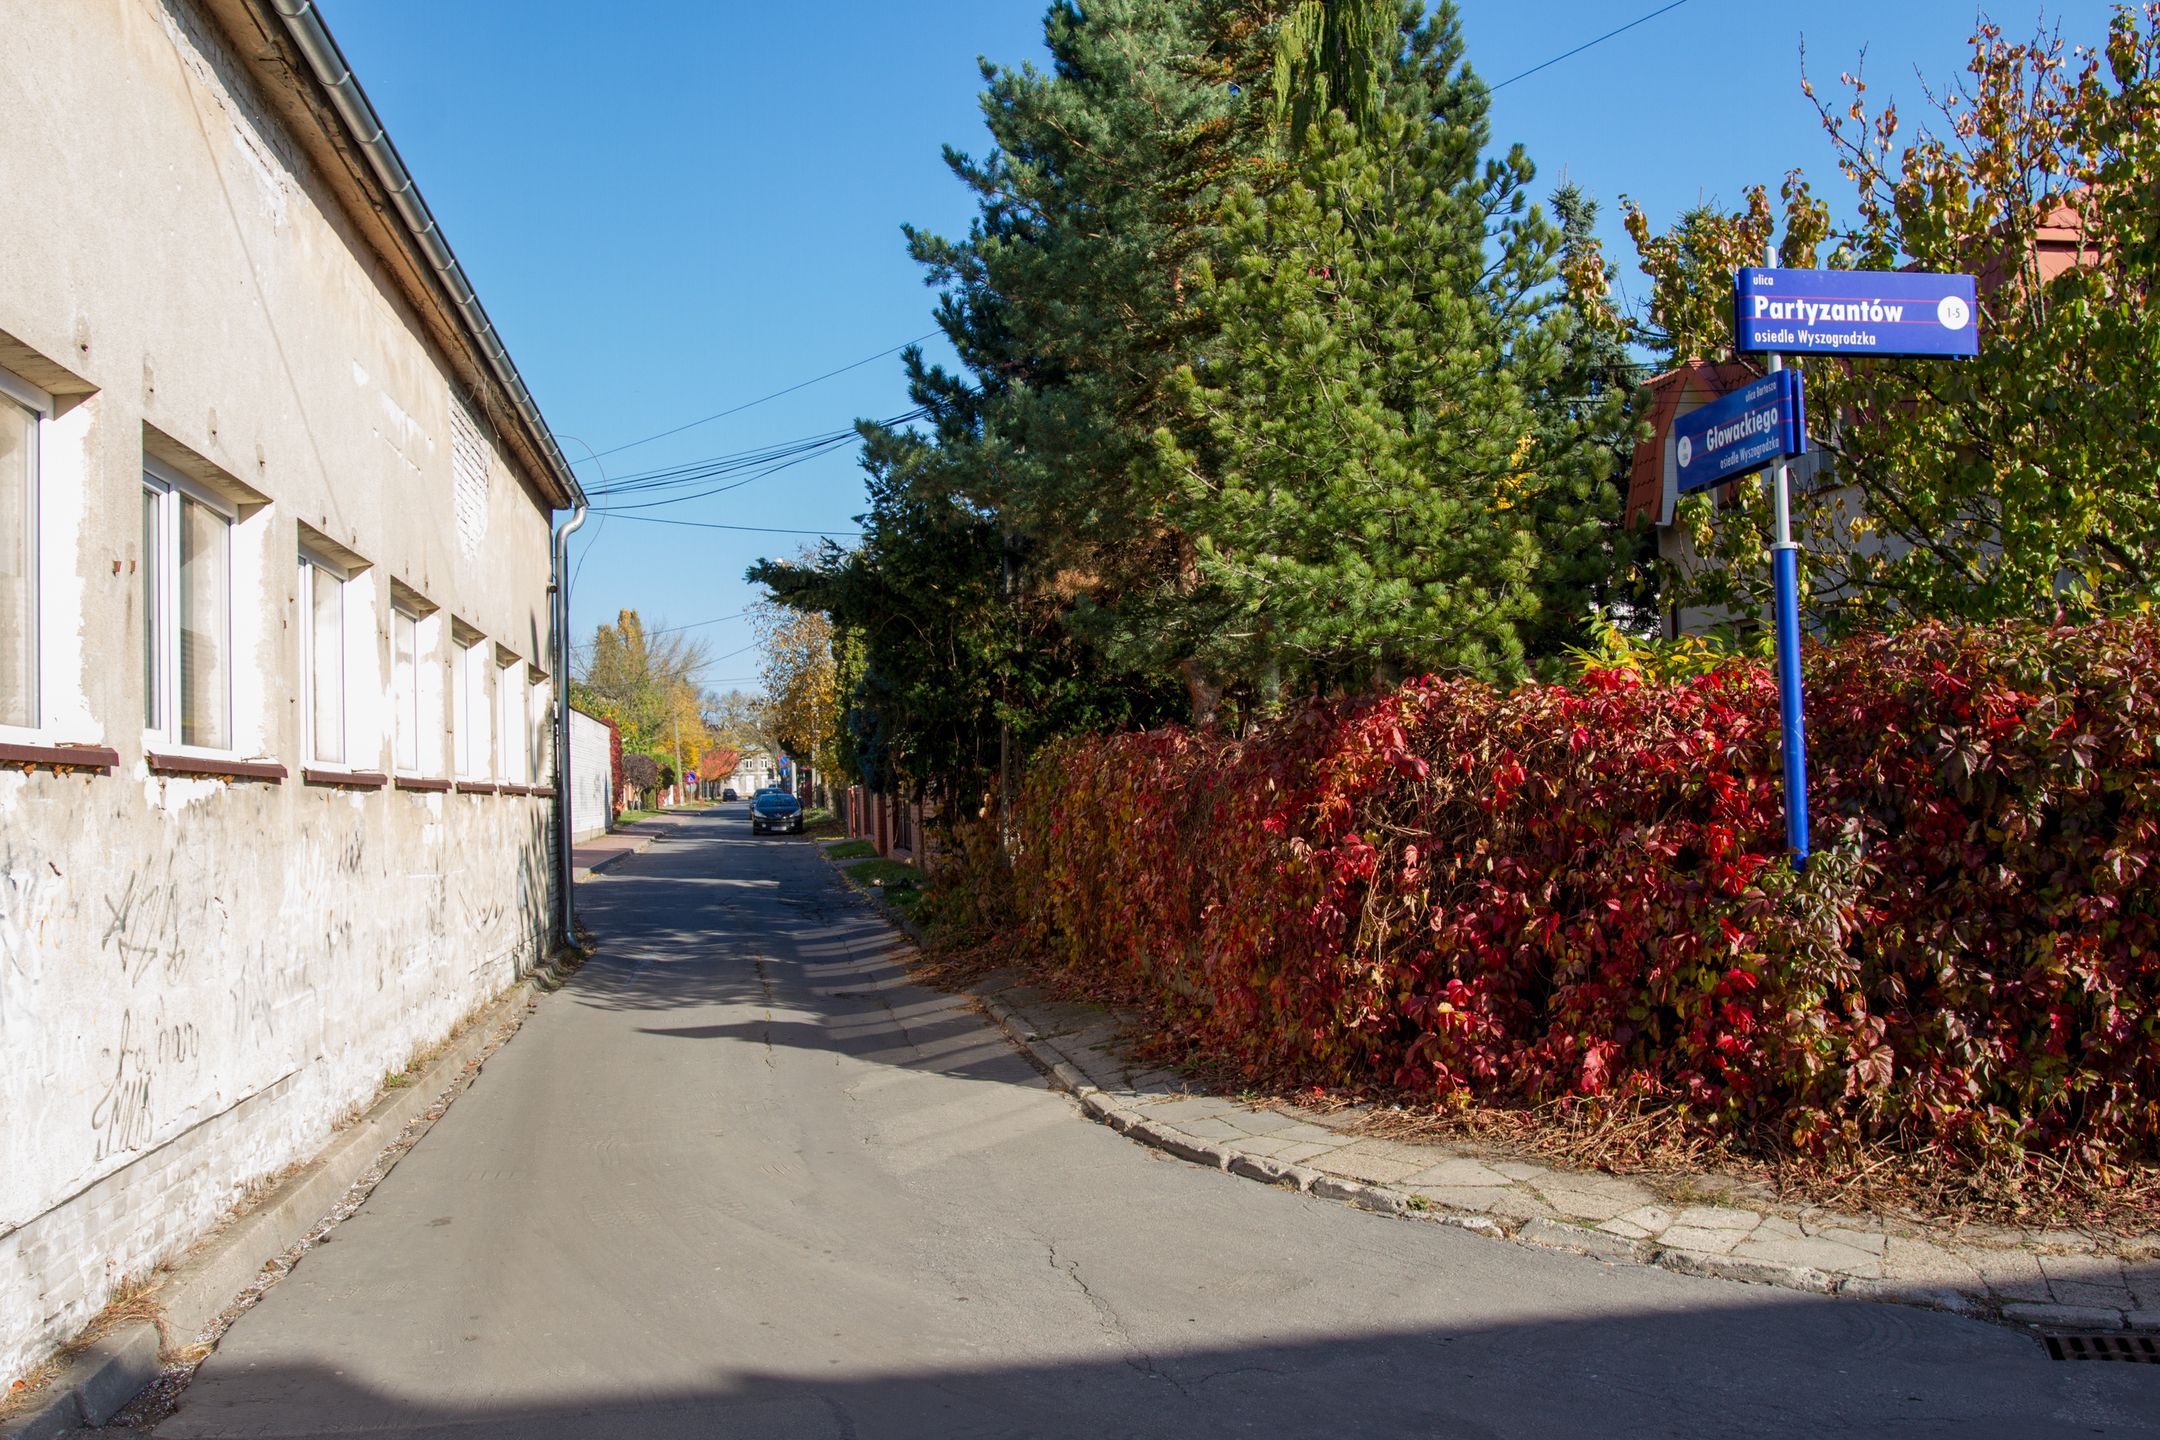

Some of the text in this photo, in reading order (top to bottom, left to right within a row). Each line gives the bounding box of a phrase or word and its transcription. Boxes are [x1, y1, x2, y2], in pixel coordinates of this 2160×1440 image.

[1752, 273, 1774, 286] ulica
[1754, 295, 1904, 326] Partyzantów
[1946, 306, 1961, 319] 1-5
[1754, 329, 1877, 348] osiedle Wyszogrodzka
[1720, 435, 1780, 470] osiedle Wyszogrodzka
